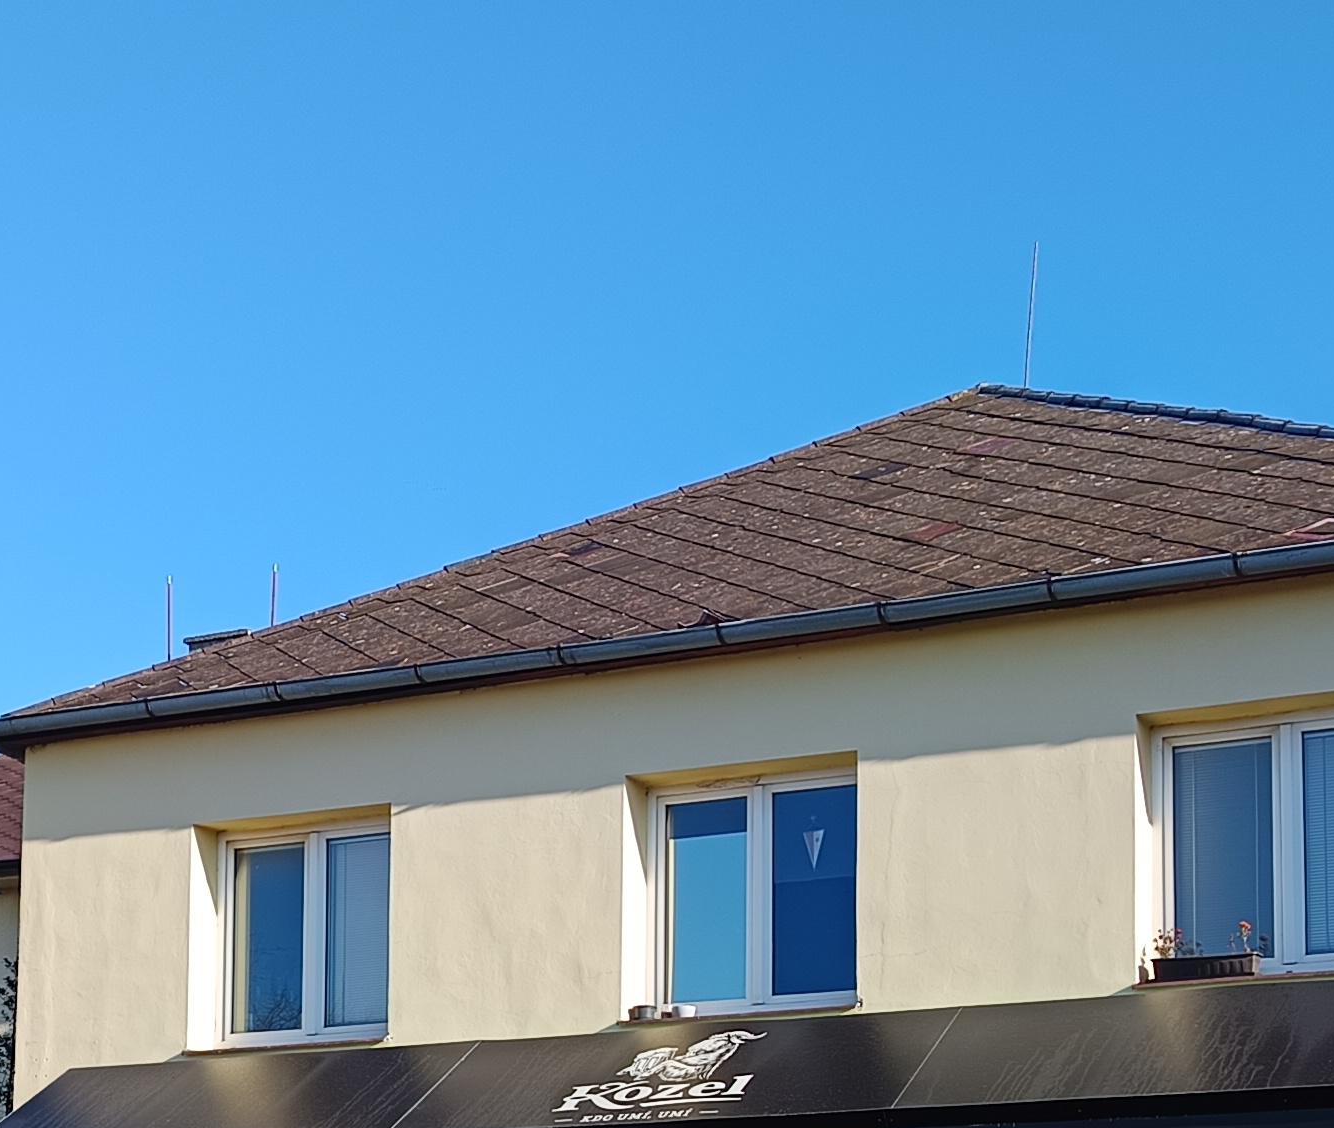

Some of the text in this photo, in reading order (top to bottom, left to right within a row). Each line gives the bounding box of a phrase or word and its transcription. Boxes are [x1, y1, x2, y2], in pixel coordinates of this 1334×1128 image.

[551, 1073, 754, 1113] Kozel
[579, 1114, 614, 1123] KDO
[657, 1107, 693, 1119] UMÍ
